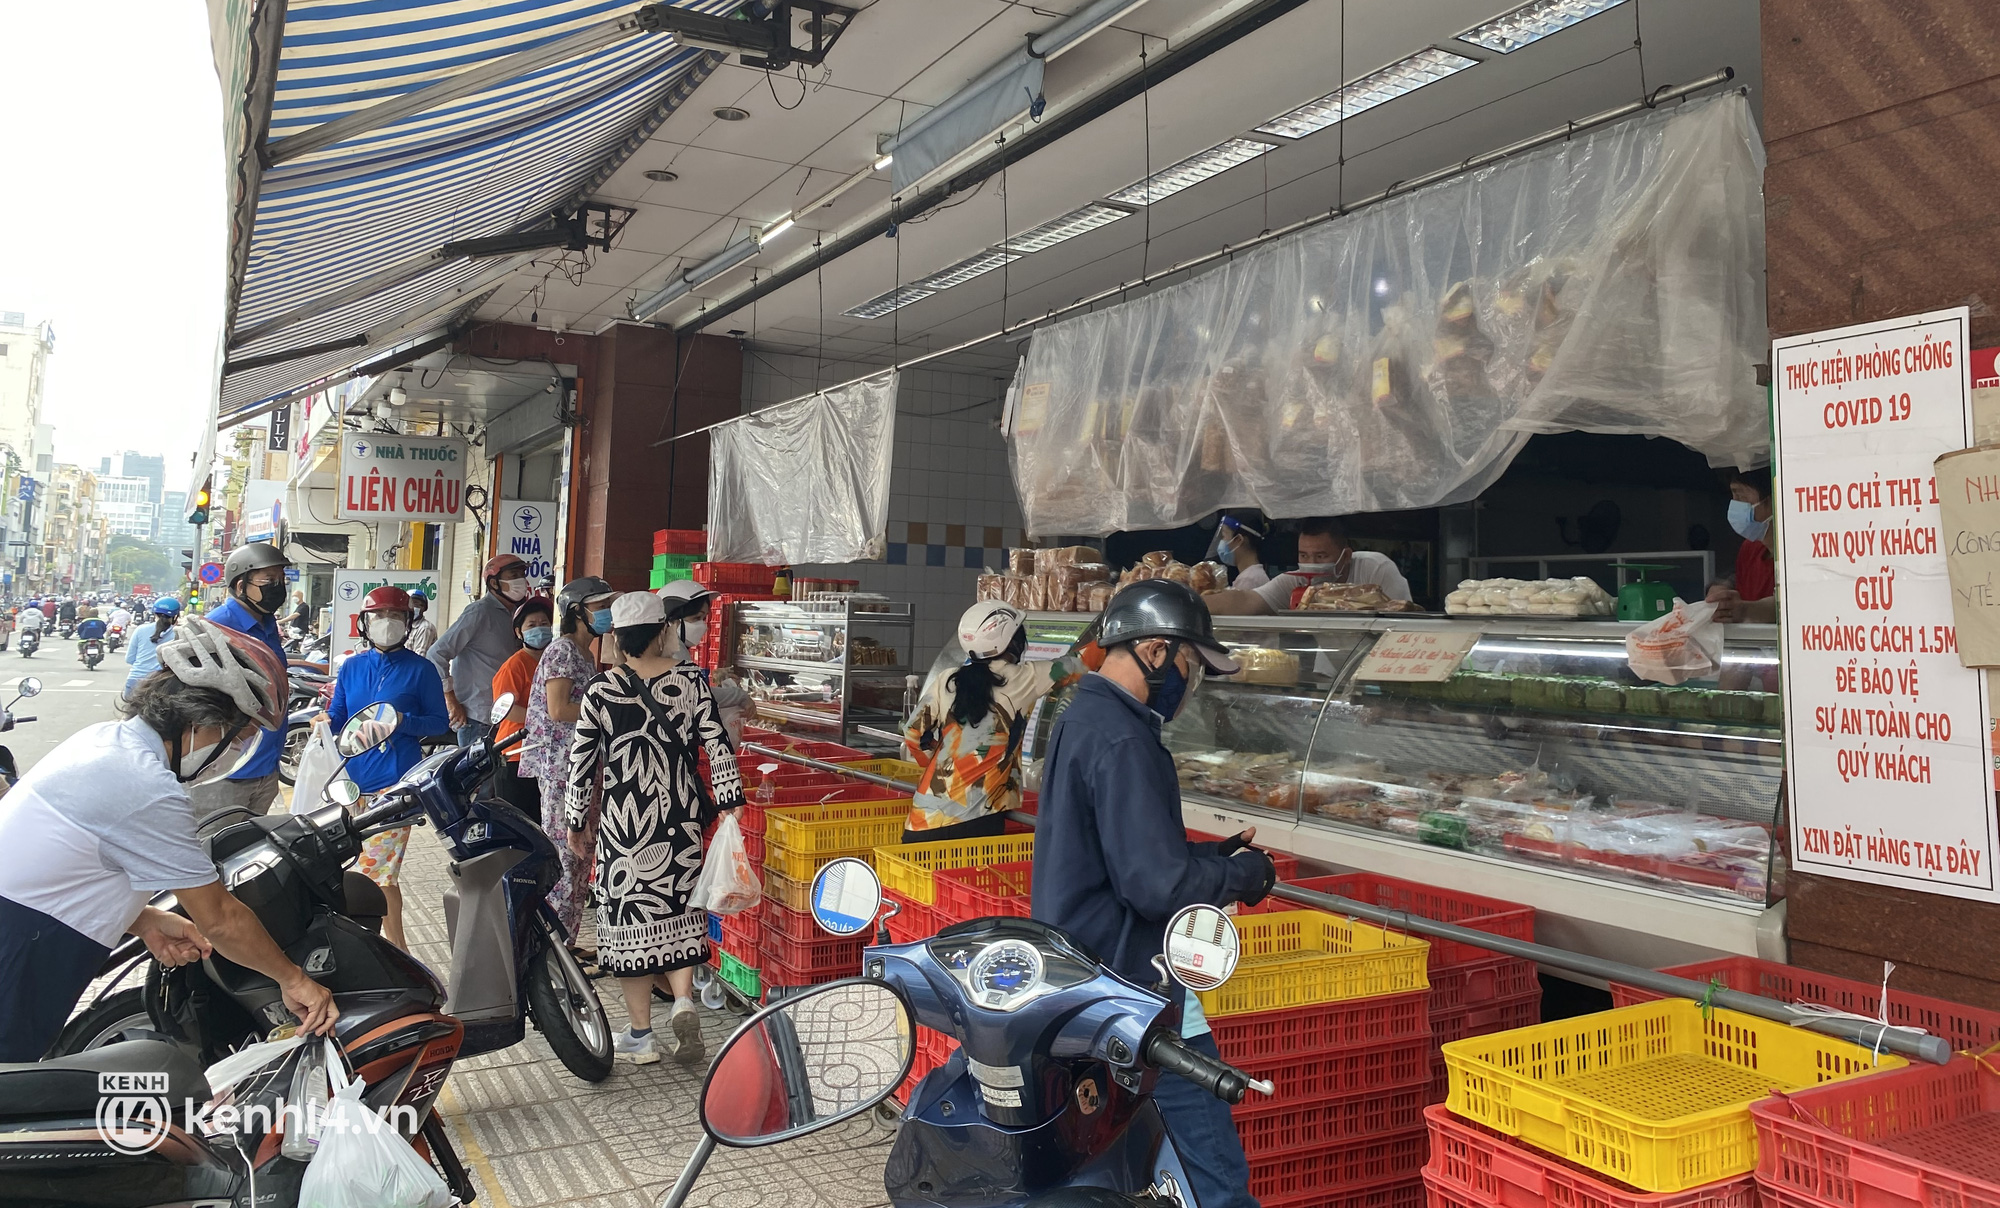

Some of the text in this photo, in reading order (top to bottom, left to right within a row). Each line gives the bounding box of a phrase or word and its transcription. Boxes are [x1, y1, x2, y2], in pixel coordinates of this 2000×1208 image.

[1786, 335, 1952, 394] THỰC HIỆN PHÒNG CHỐNG
[1824, 393, 1911, 428] COVID 19
[375, 444, 458, 461] NHÀ THUỐC
[347, 466, 460, 514] LIÊN CHÂU
[1795, 484, 1841, 512] THEO
[1848, 472, 1881, 509] CHỈ
[1886, 478, 1922, 512] THỊ
[511, 533, 541, 555] NHÀ
[1812, 520, 1936, 563] XIN QUÝ KHÁCH
[1855, 566, 1894, 610] GIỮ
[1802, 617, 1959, 653] KHOẢNG CÁCH 1.5M
[1836, 659, 1918, 702] ĐỂ BẢO VỆ
[1816, 702, 1951, 741] SỰ AN TOÀN CHO
[1838, 743, 1930, 783] QUÝ KHÁCH
[1803, 826, 1980, 876] XIN ĐẶT HÀNG TẠI ĐÂY
[513, 877, 537, 885] HONDA
[429, 1044, 455, 1058] HONDA
